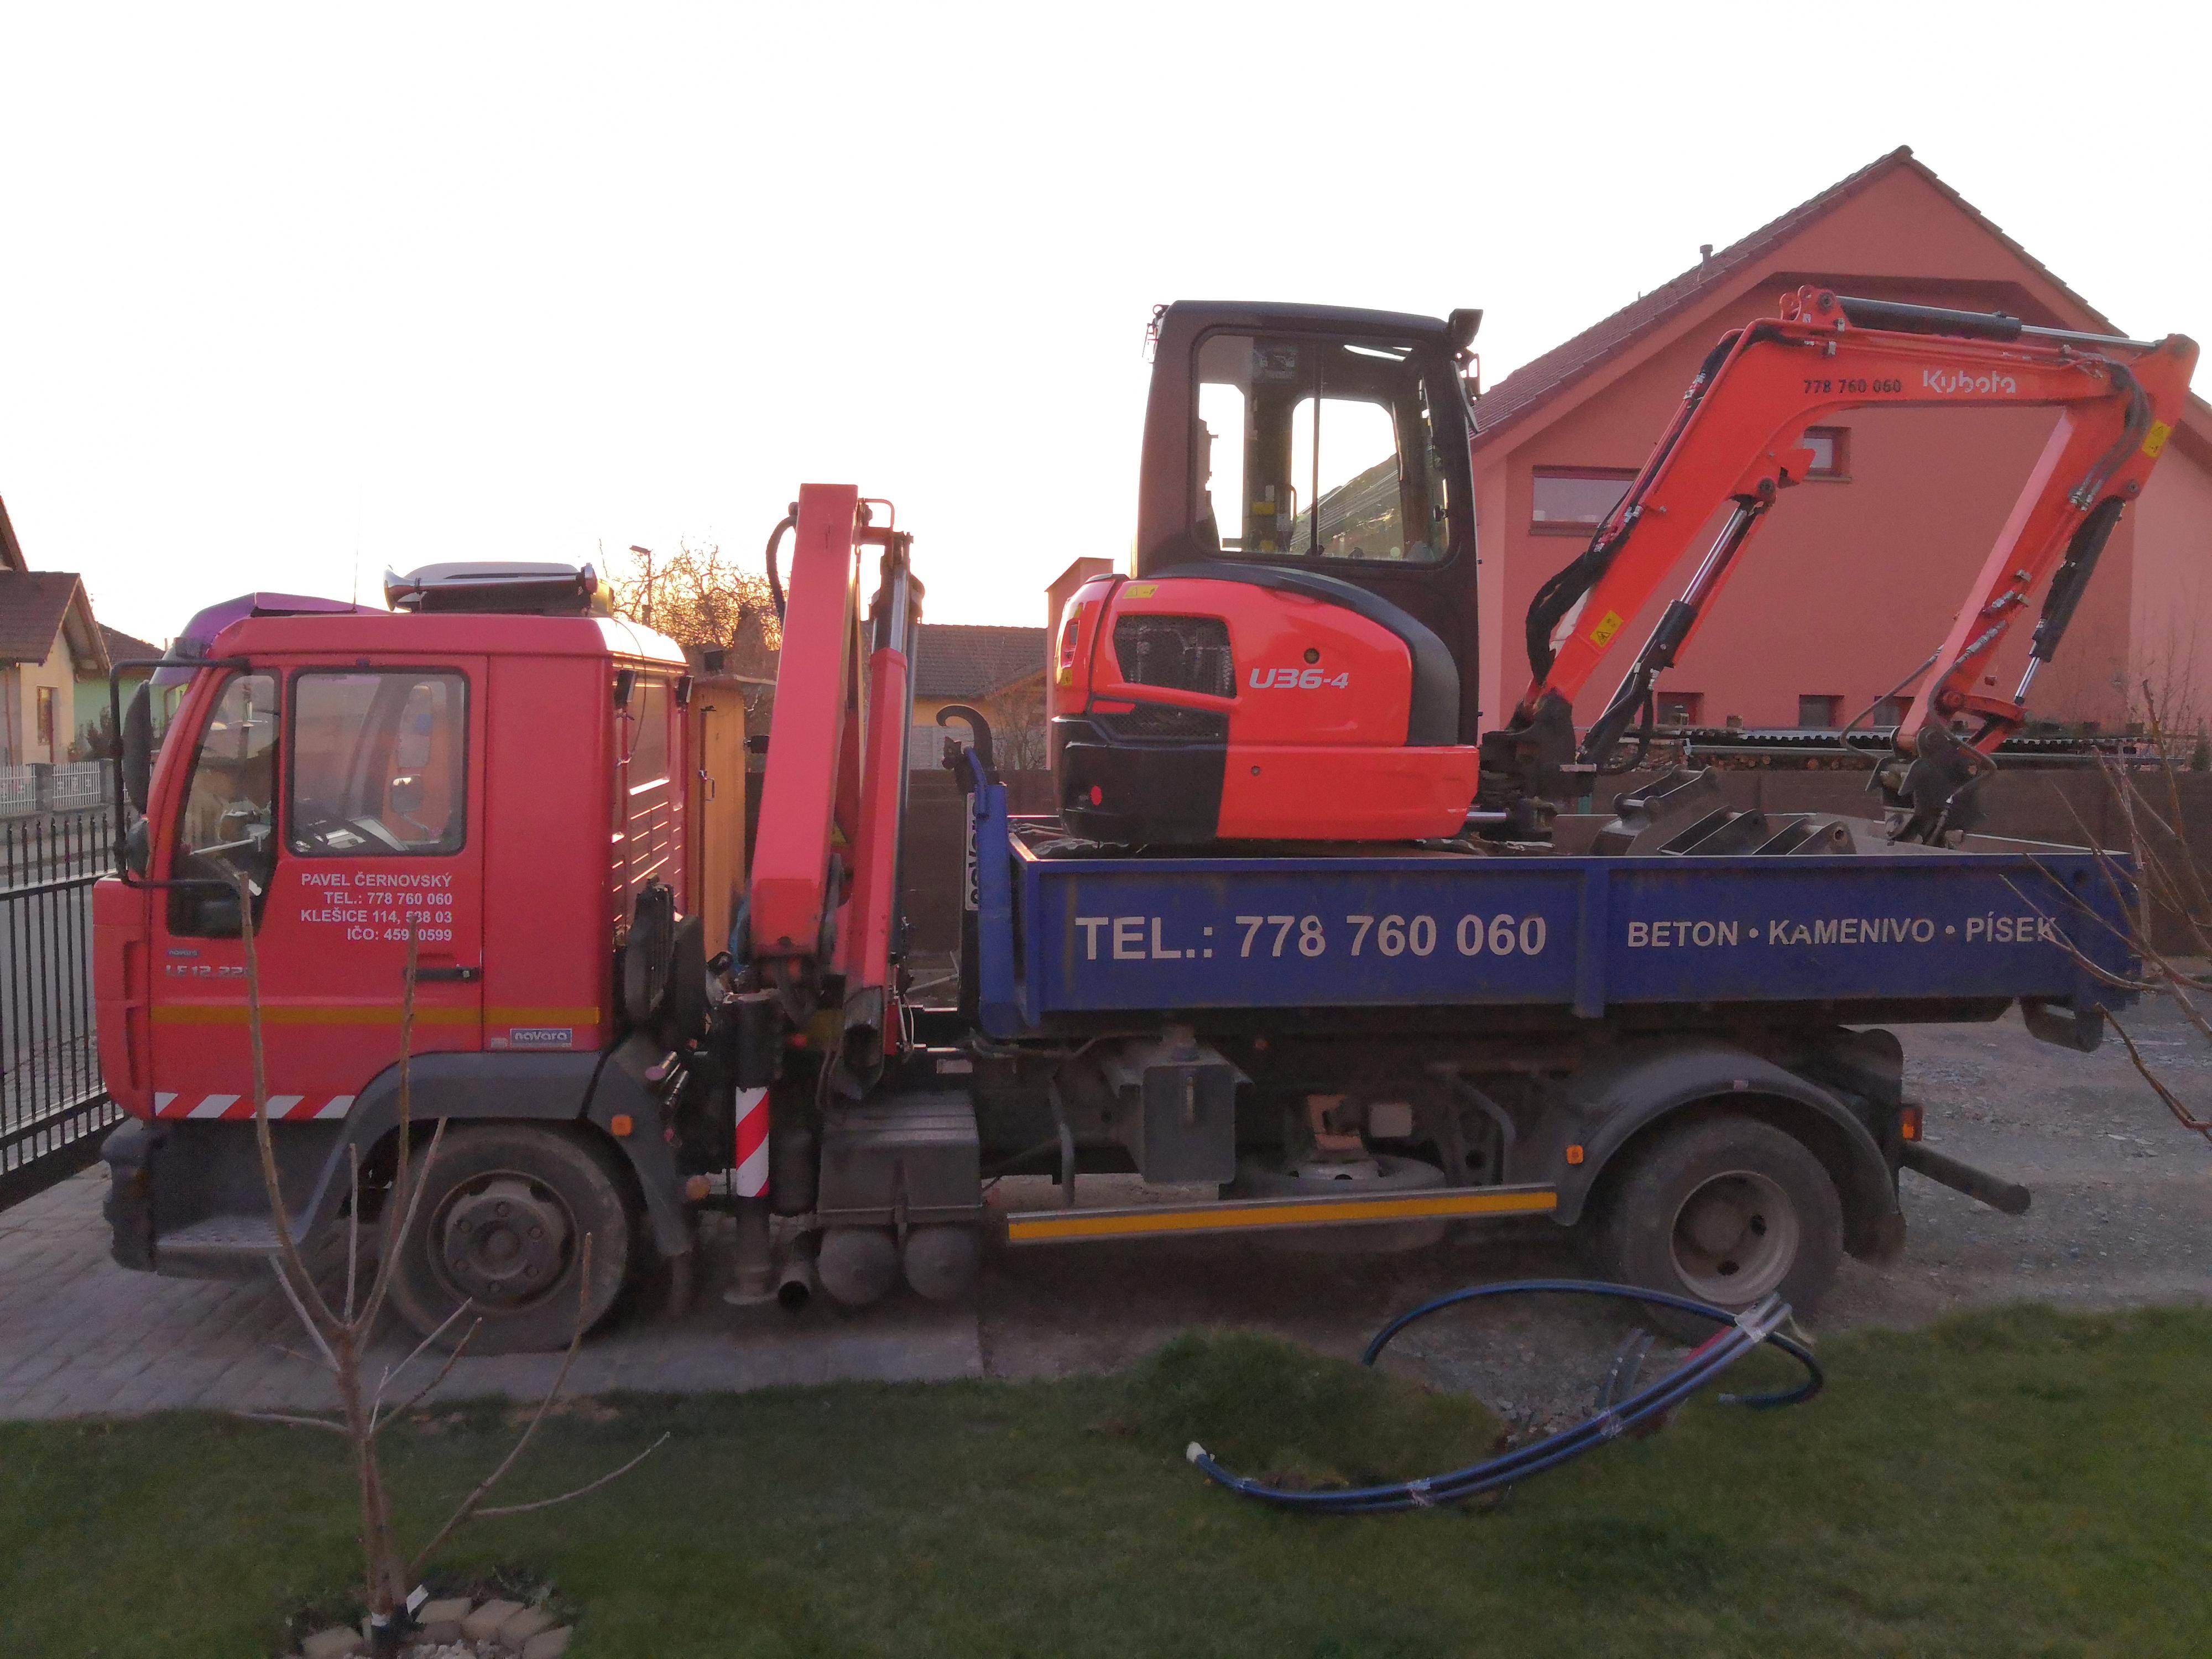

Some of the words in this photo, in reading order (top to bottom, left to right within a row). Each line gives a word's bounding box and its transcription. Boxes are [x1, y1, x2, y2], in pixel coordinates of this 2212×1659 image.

[1804, 379, 1831, 394] 778
[1838, 379, 1867, 393] 760
[1873, 379, 1902, 393] 060
[1923, 370, 2016, 393] Kubota
[1249, 668, 1349, 689] U36-4
[301, 873, 350, 886] PAVEL
[354, 872, 452, 888] ČERNOVSKÝ
[324, 891, 362, 904] TEL.:
[367, 892, 393, 905] 778
[397, 893, 422, 905] 760
[427, 893, 452, 905] 060
[301, 907, 367, 922] KLEŠICE
[372, 911, 401, 925] 114,
[435, 911, 452, 923] 03
[347, 925, 379, 941] IČO:
[1075, 916, 1213, 960] TEL.:
[1235, 915, 1326, 958] 778
[1347, 915, 1437, 957] 760
[1456, 914, 1547, 956] 060
[1627, 921, 1739, 947] BETON
[1769, 918, 1936, 945] KAMENIVO
[1966, 911, 2056, 942] PÍSEK
[515, 1031, 567, 1041] novara
